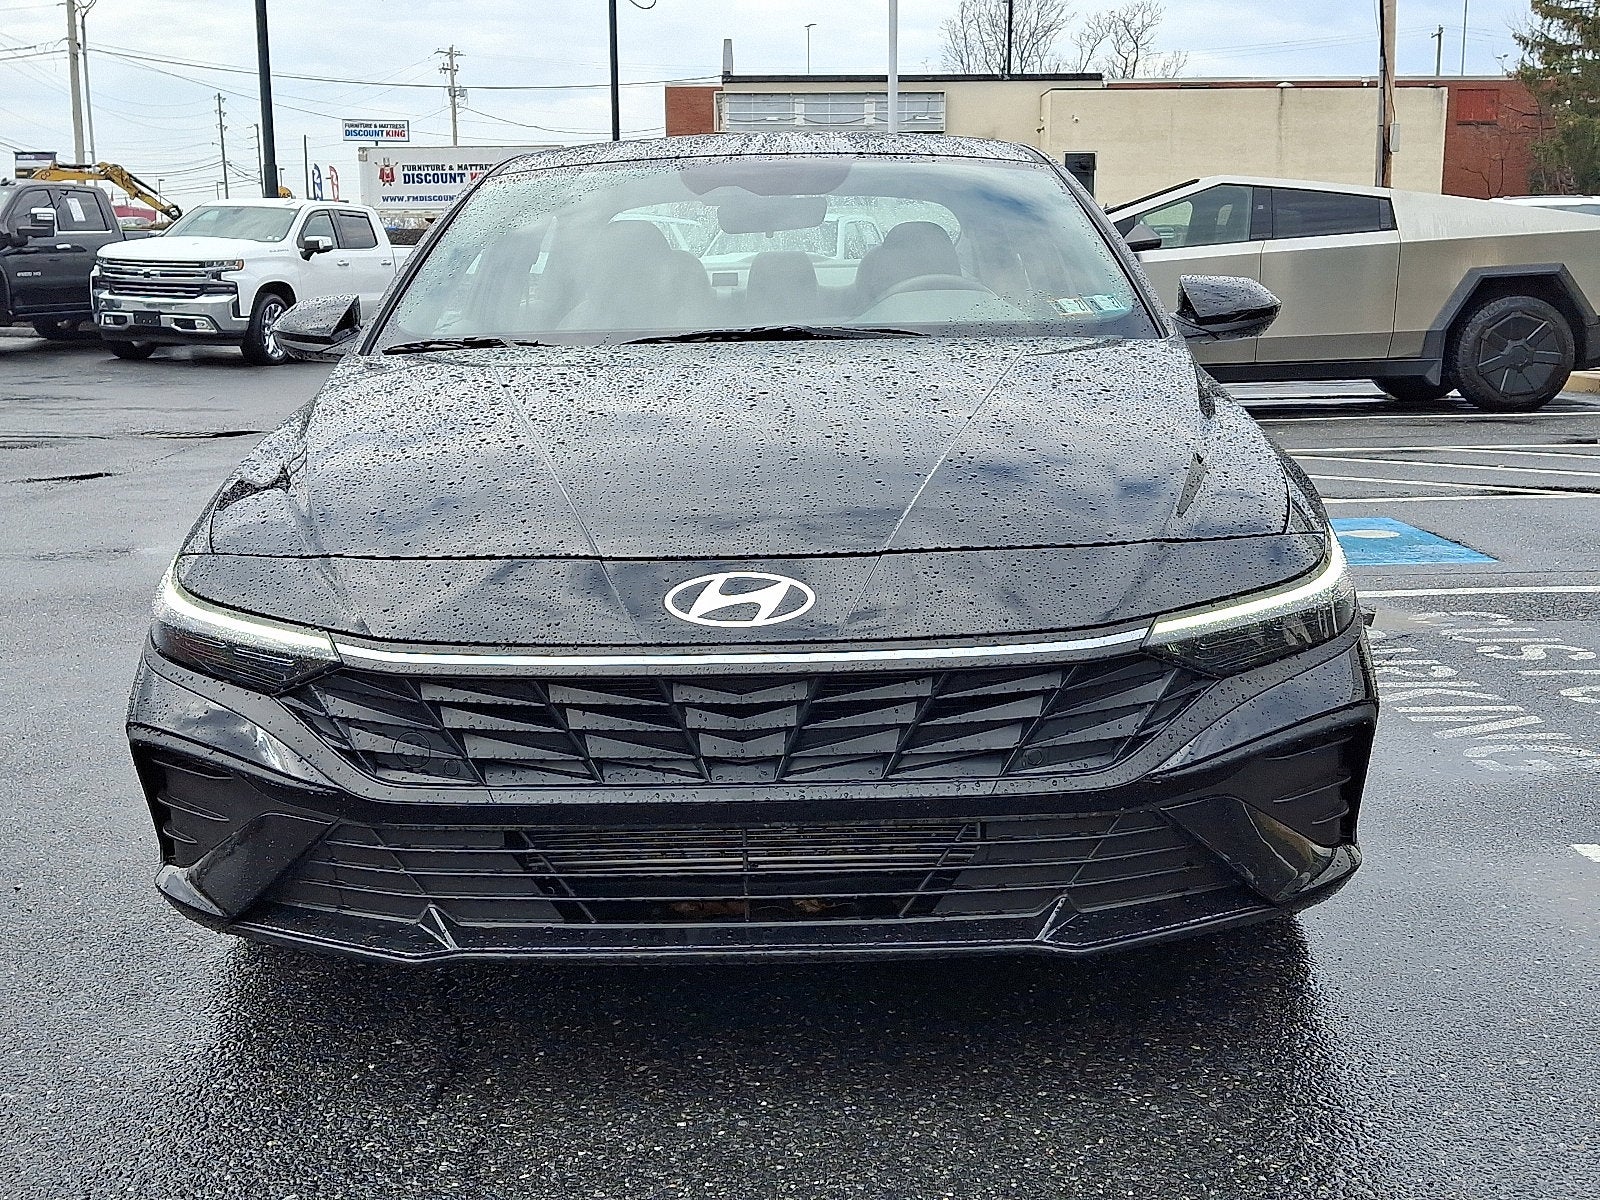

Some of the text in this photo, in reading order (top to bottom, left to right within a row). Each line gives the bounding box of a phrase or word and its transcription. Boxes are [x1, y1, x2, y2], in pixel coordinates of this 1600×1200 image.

[344, 129, 385, 137] DISCOUNT
[401, 164, 446, 172] FURNITURE
[448, 164, 455, 172] &
[402, 172, 467, 185] DISCOUNT
[381, 194, 457, 203] WWW.FMDISCOUN
